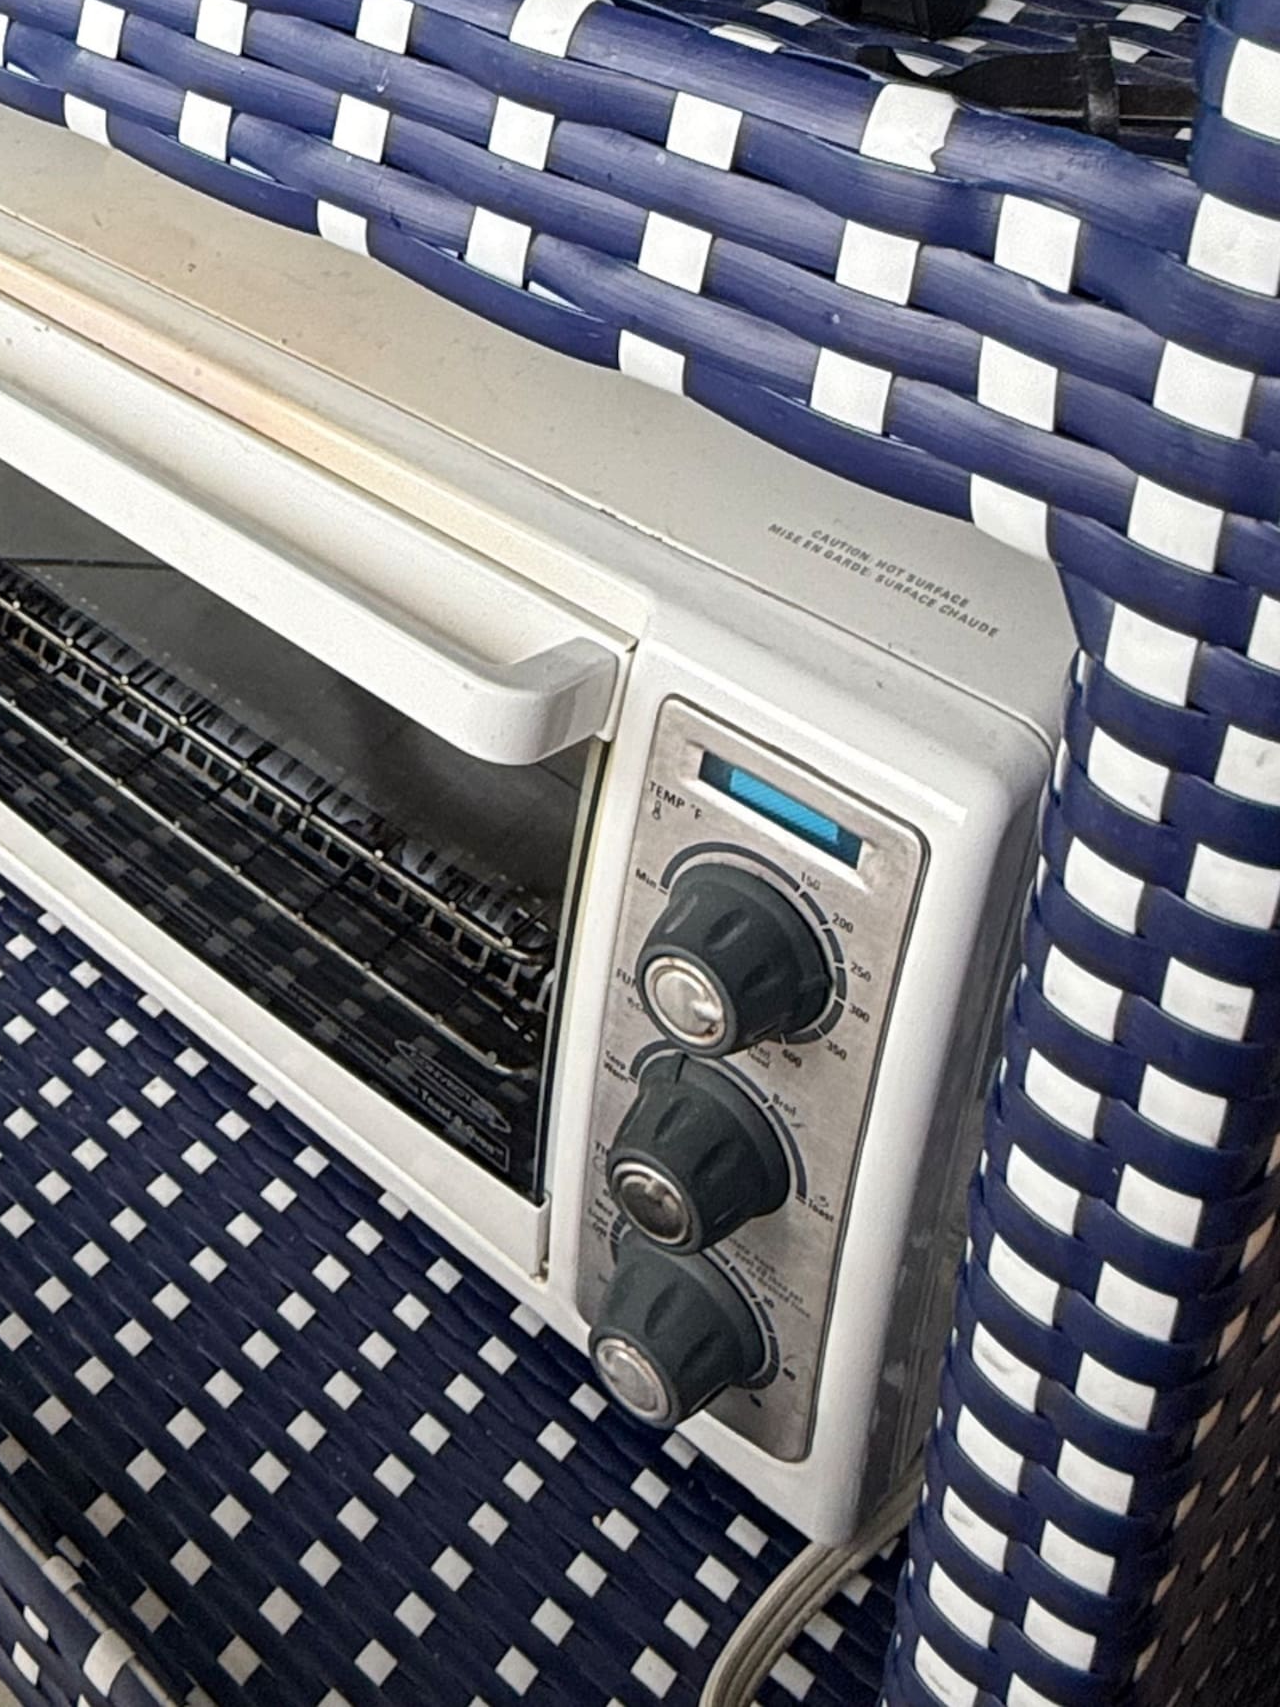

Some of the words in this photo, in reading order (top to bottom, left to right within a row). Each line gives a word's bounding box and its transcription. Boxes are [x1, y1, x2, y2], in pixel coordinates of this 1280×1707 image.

[768, 523, 803, 545] MISE
[802, 539, 823, 554] EN
[875, 573, 937, 608] SURFACE
[938, 604, 999, 638] CHAUDE
[875, 559, 905, 577] HOT
[905, 573, 970, 609] SURFACE
[650, 781, 685, 808] TEMP
[635, 867, 657, 889] Min
[800, 871, 822, 892] 150
[832, 912, 854, 934] 200
[850, 961, 872, 983] 250
[848, 1002, 870, 1024] 300
[826, 1039, 847, 1061] 350
